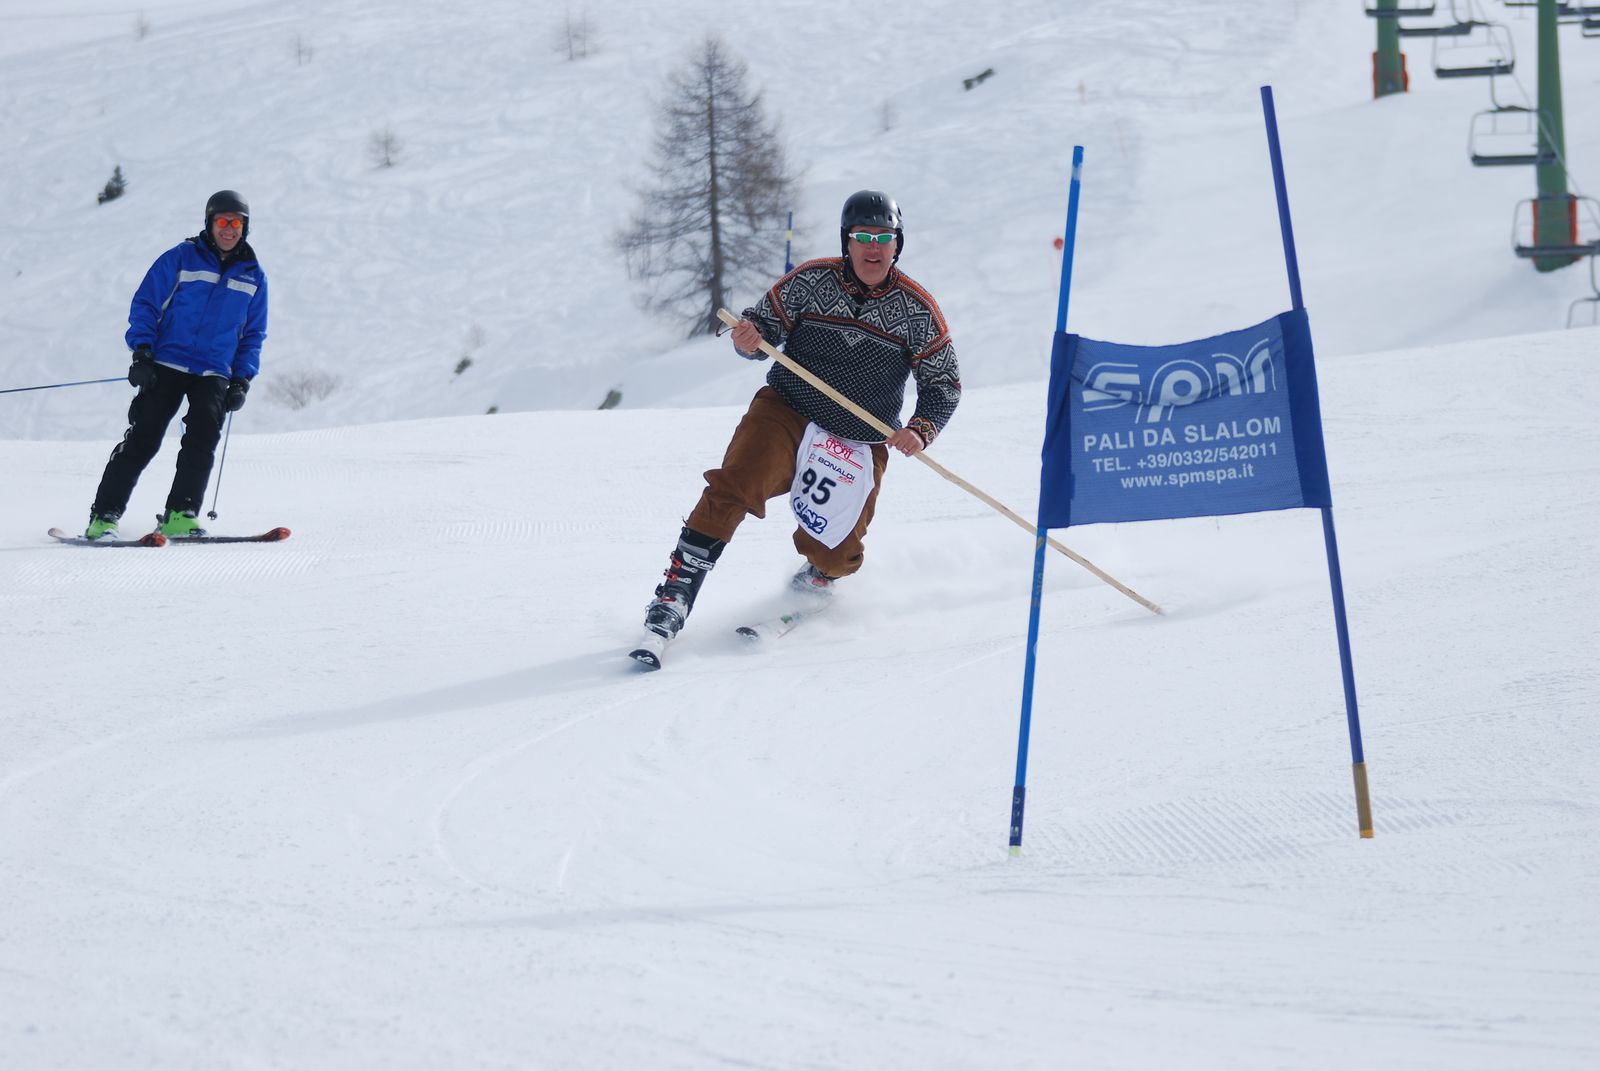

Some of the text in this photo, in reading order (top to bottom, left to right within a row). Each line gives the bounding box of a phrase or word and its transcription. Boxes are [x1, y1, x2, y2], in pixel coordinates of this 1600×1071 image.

[1083, 416, 1281, 452] PALI DA SLALOM
[817, 456, 855, 481] BONALDI
[1092, 442, 1277, 473] TEL. +39/0332/542011
[801, 467, 837, 505] 95
[1120, 463, 1255, 489] www.spmspa.it
